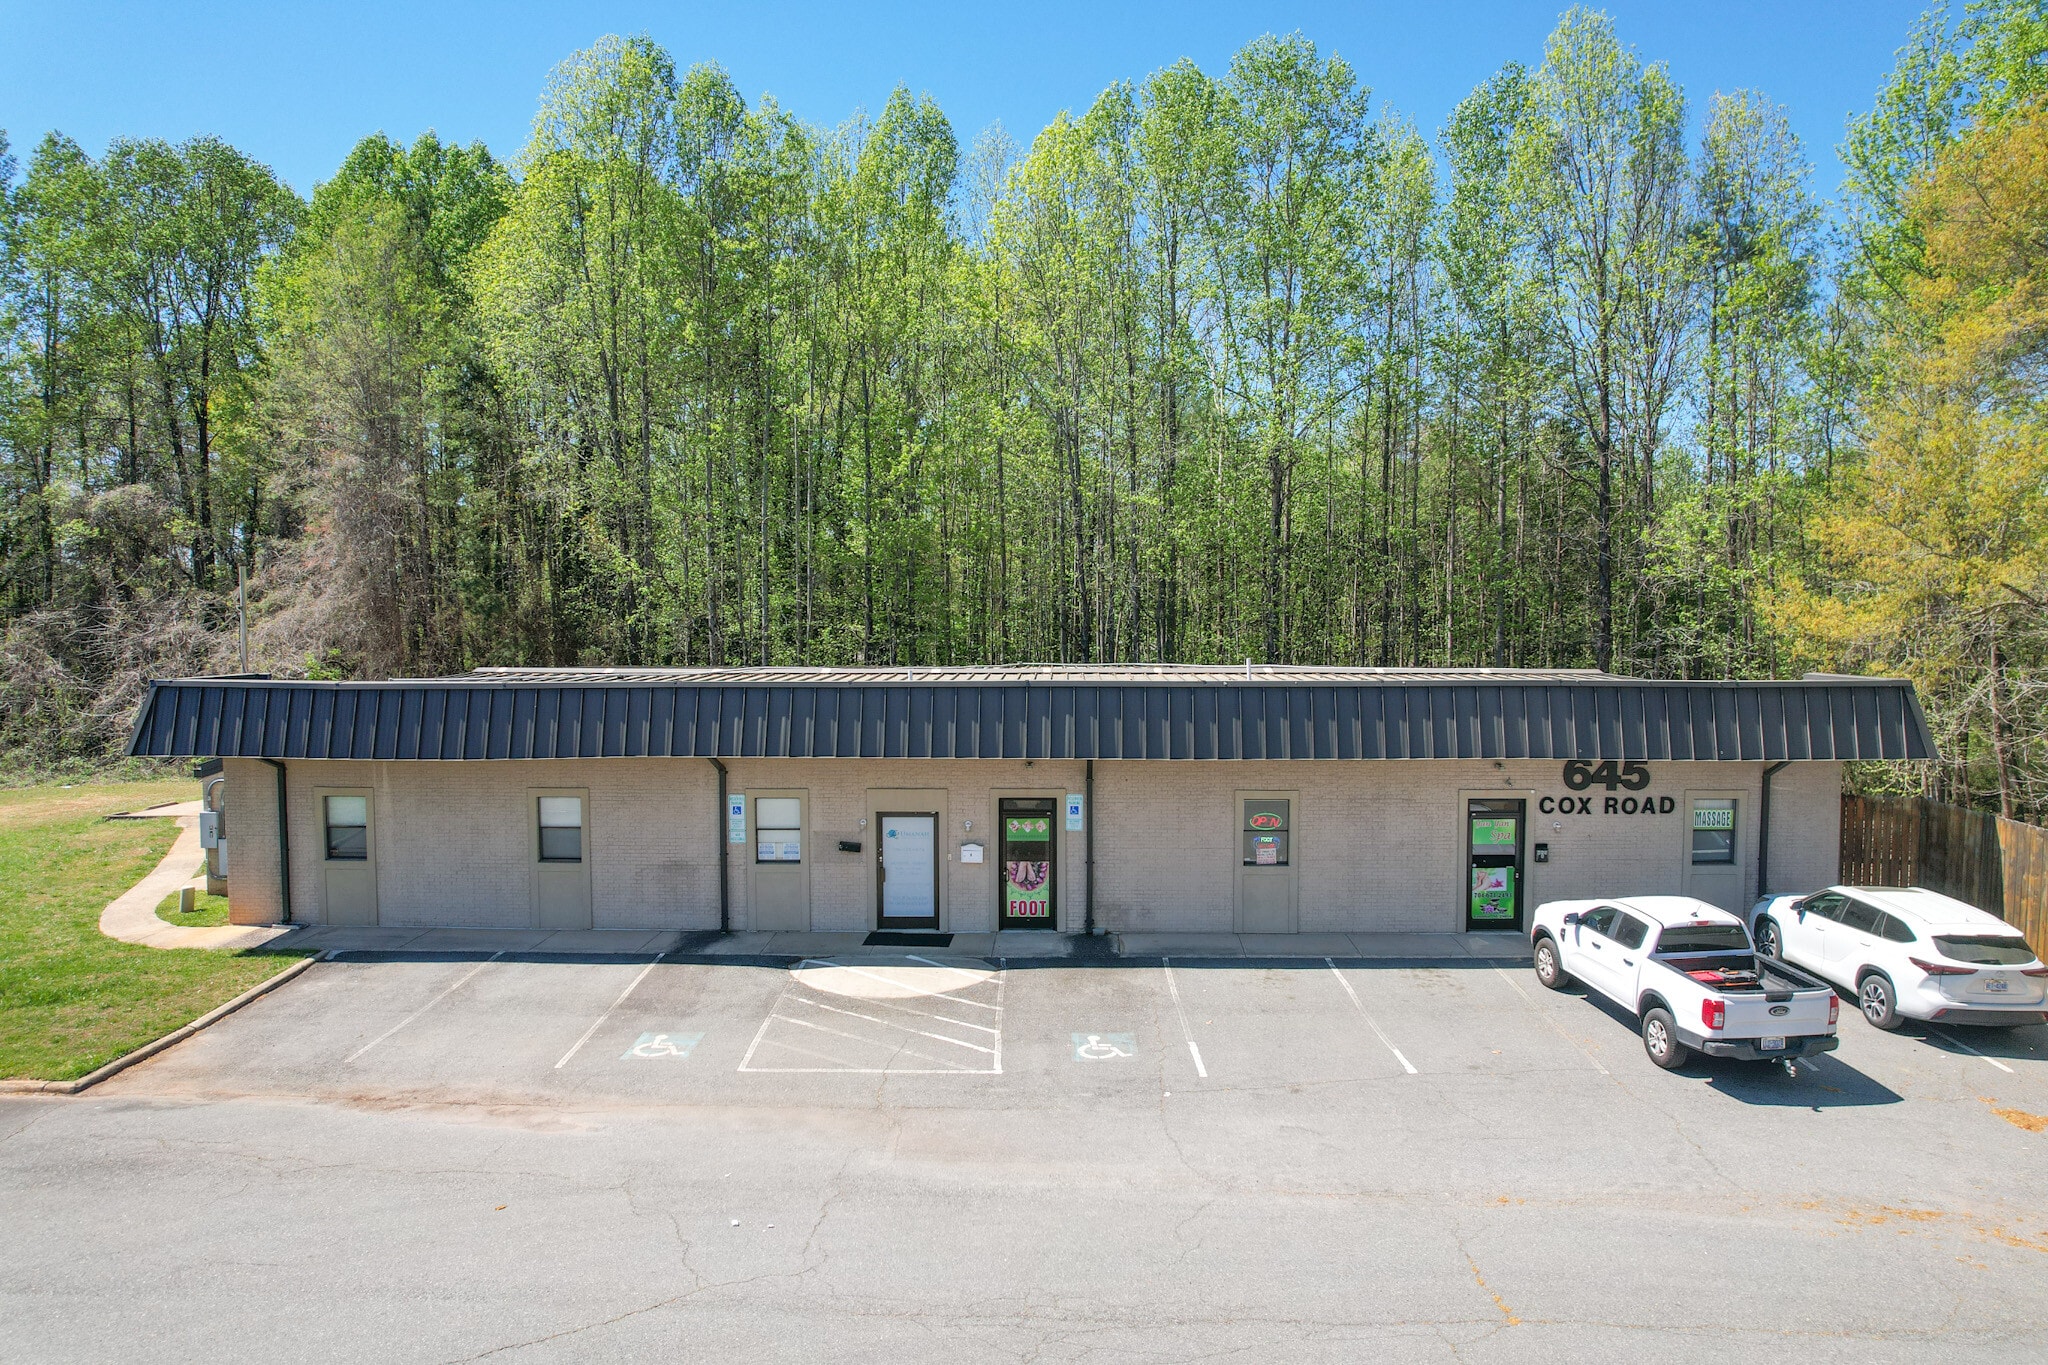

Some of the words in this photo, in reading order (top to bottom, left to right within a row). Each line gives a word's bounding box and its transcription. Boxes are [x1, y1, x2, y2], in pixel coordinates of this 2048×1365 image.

[1563, 759, 1650, 791] 645
[1539, 796, 1592, 815] COX
[1604, 796, 1675, 815] ROAD
[1252, 816, 1279, 827] OPN
[1694, 811, 1731, 827] MASSAGE
[1490, 830, 1510, 844] Spa
[1010, 900, 1047, 916] FOOT
